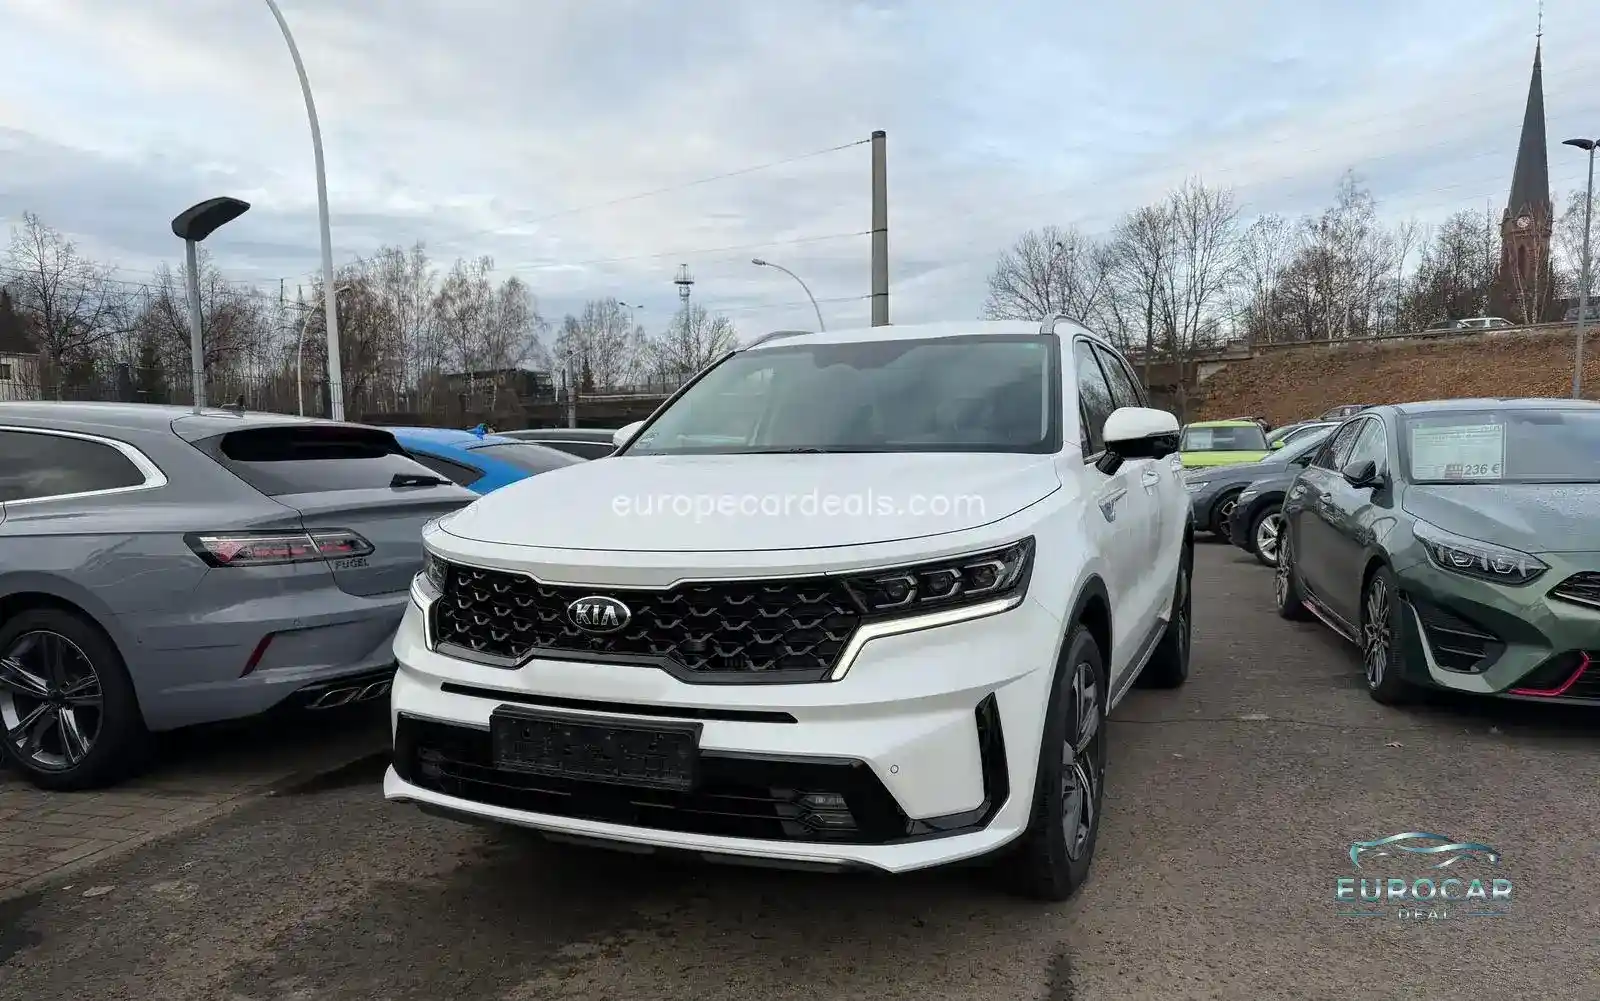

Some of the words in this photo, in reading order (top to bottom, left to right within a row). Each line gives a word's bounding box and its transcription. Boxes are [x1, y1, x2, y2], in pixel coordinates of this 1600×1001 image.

[1463, 464, 1488, 475] 236
[1491, 463, 1500, 474] €
[576, 603, 619, 626] KIA
